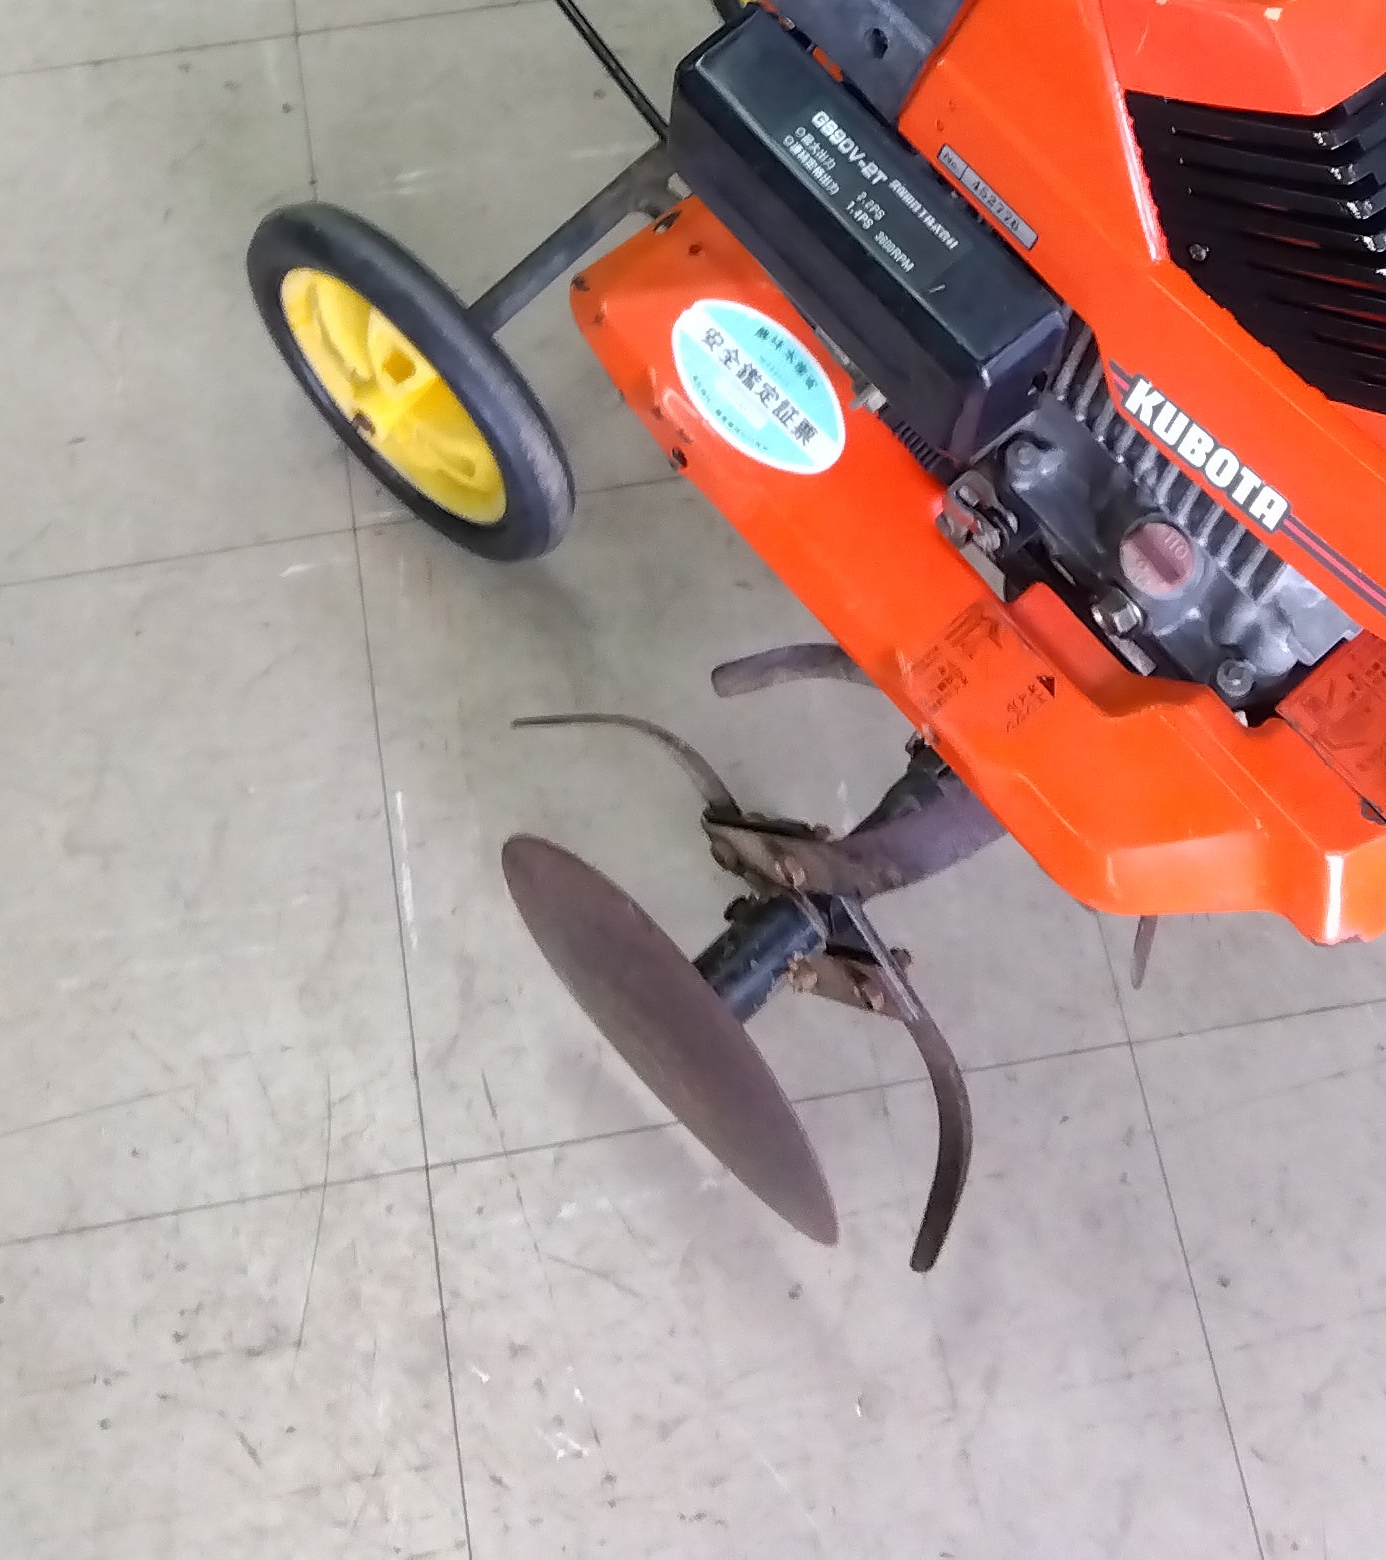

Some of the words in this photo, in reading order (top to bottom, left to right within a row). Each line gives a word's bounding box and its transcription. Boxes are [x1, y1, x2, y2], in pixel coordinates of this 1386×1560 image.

[701, 327, 820, 448] 安全鑑定証票
[1124, 379, 1288, 528] KUBOTA
